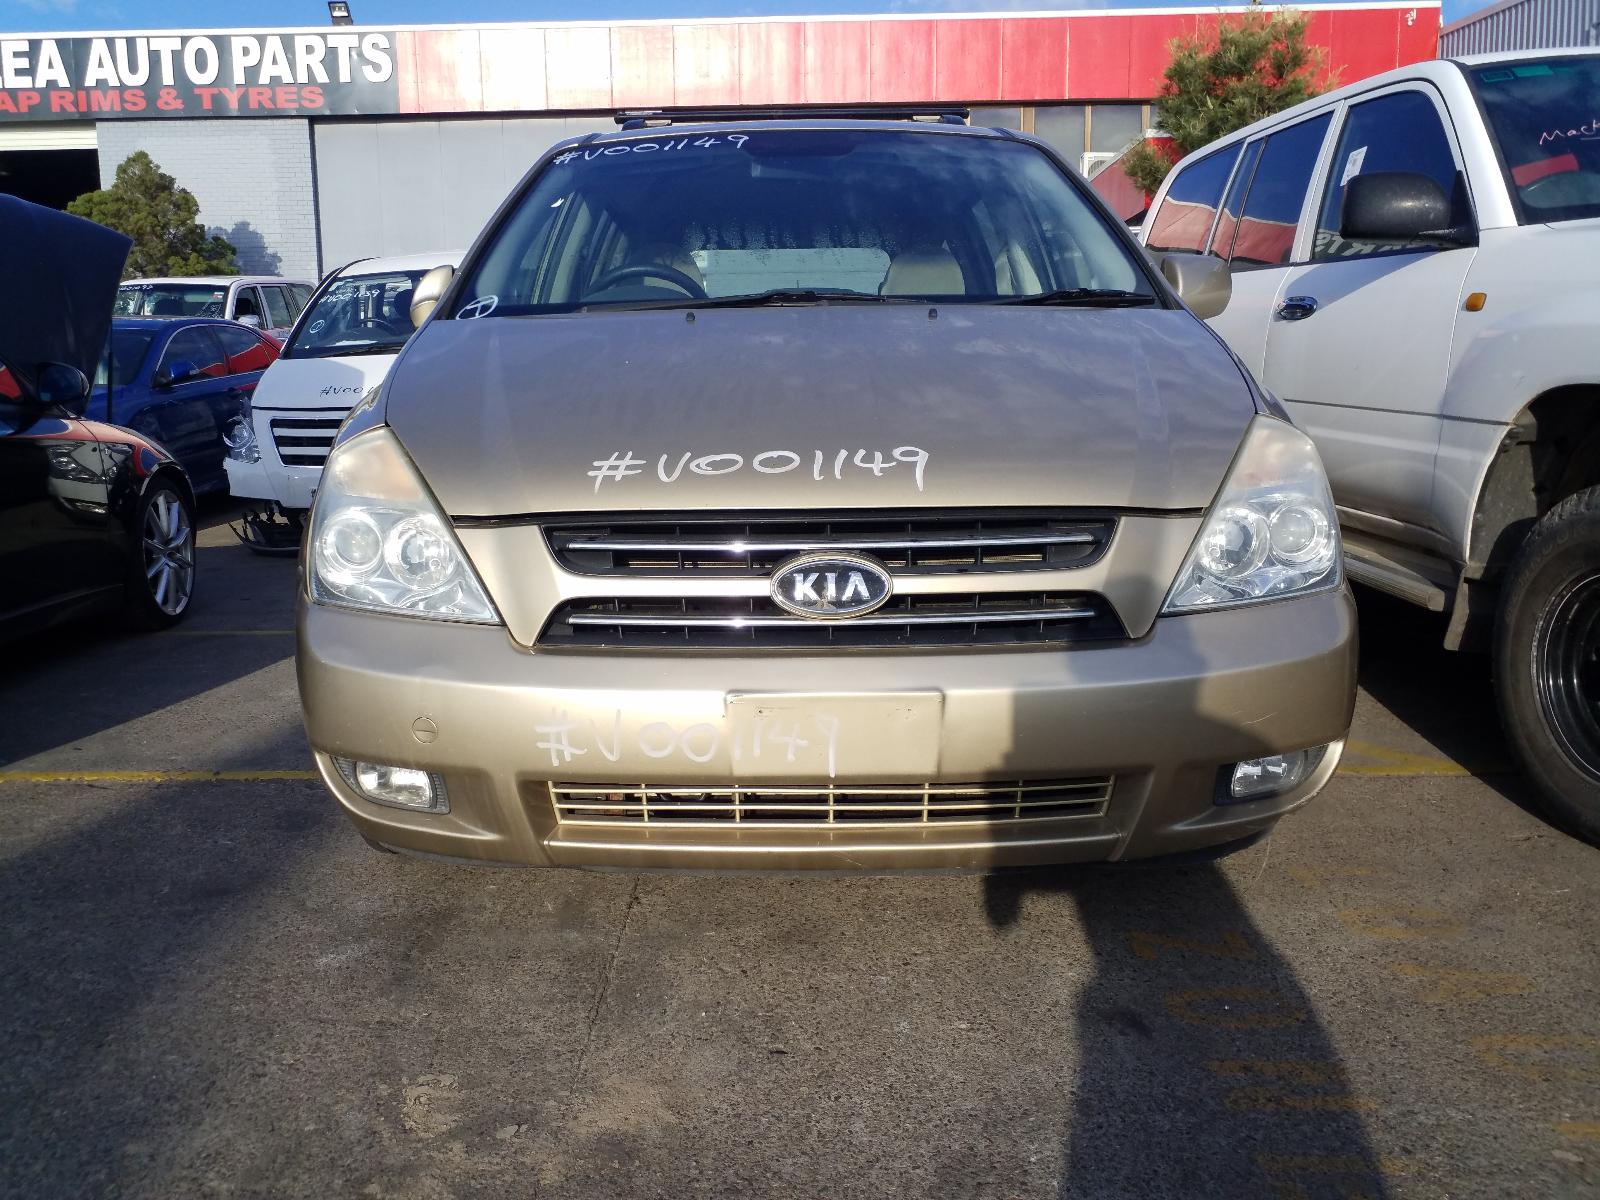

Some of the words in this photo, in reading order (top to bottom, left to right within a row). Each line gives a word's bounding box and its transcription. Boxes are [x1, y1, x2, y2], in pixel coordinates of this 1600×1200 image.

[0, 38, 71, 89] EA
[85, 35, 220, 88] AUTO
[231, 33, 394, 86] PARTS
[51, 88, 146, 113] RIMS
[156, 87, 185, 111] &
[194, 86, 325, 111] TYRES
[553, 134, 750, 165] #V001149
[586, 446, 930, 494] #V001149
[793, 570, 870, 602] KIA
[534, 707, 841, 777] #V001149
